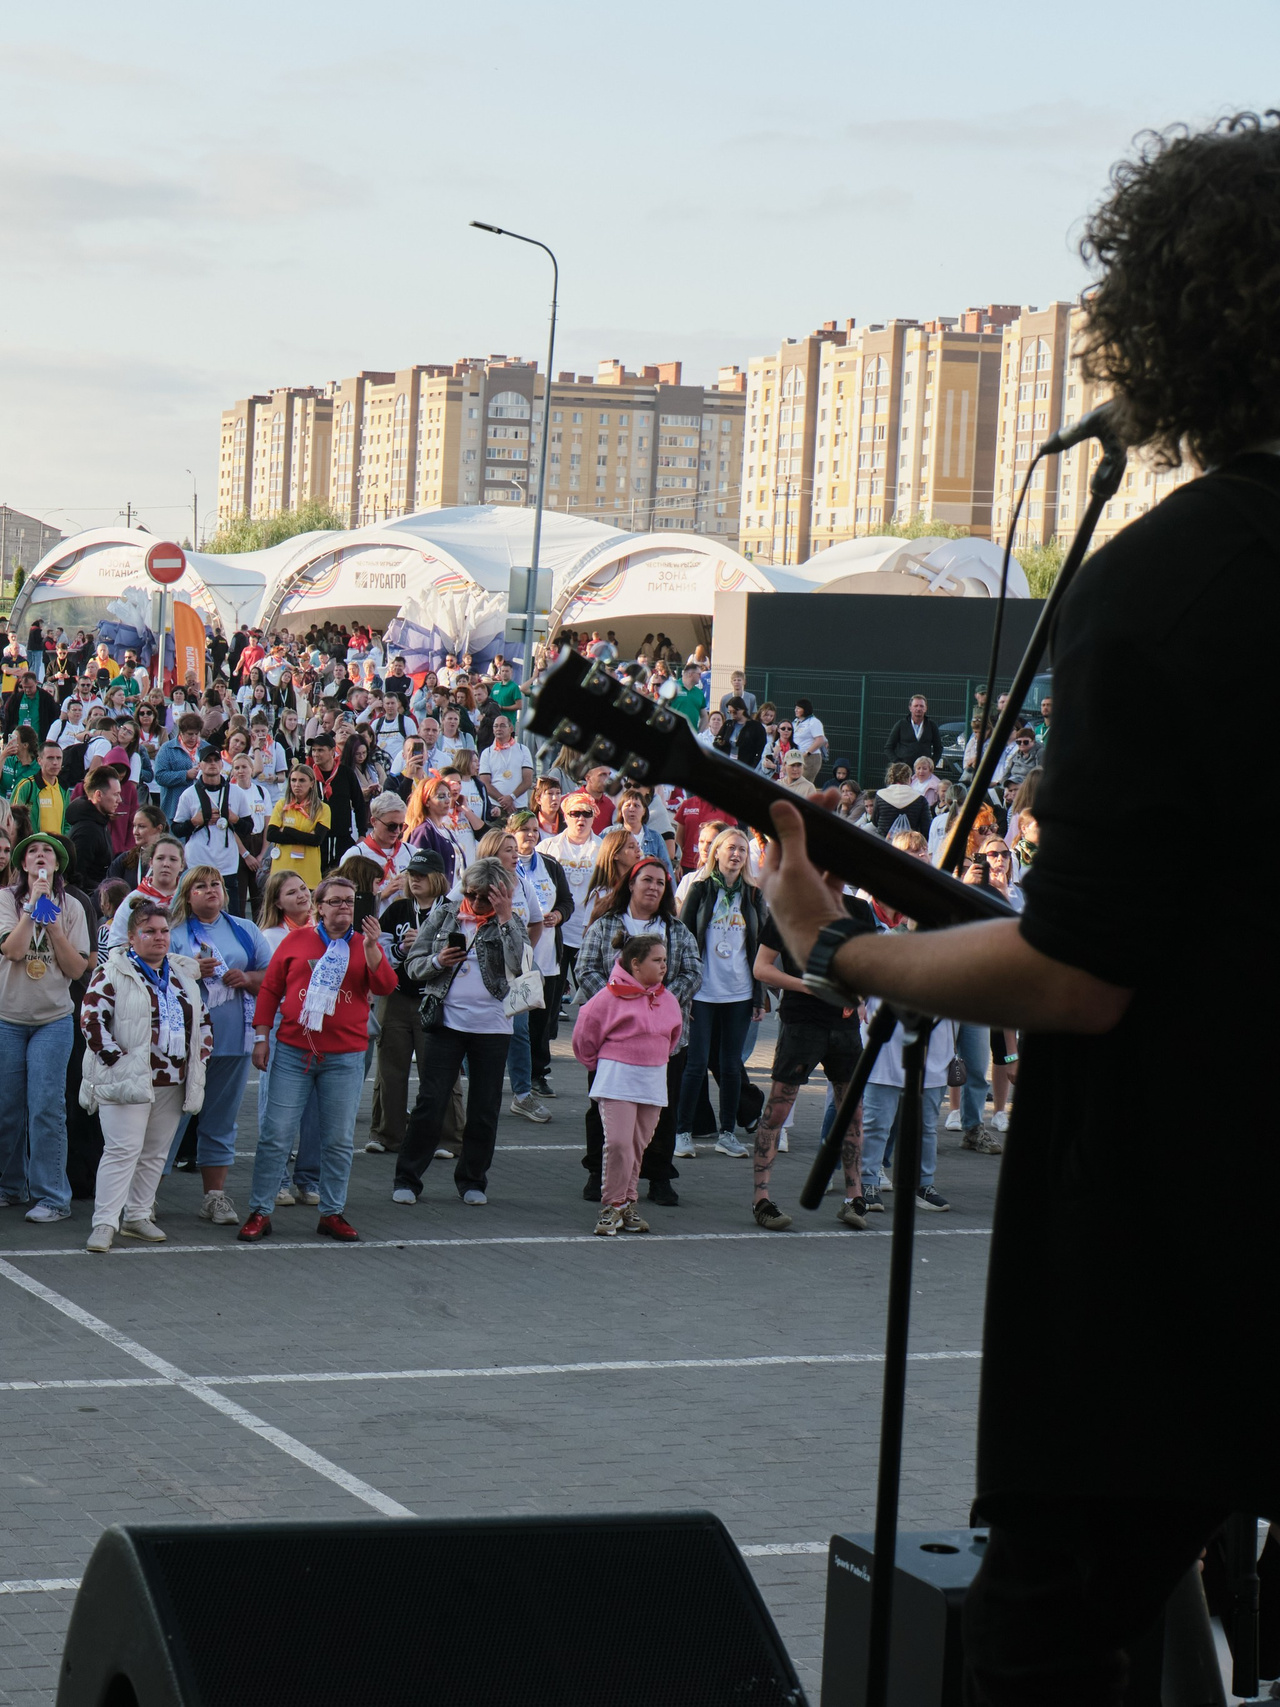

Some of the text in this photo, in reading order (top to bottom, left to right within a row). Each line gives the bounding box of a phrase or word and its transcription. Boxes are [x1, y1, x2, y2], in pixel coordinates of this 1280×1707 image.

[369, 573, 406, 589] РУСАГРО
[658, 571, 687, 581] ЗОНА
[648, 582, 697, 592] ПИТАНИЯ
[185, 646, 195, 671] УСАГРО
